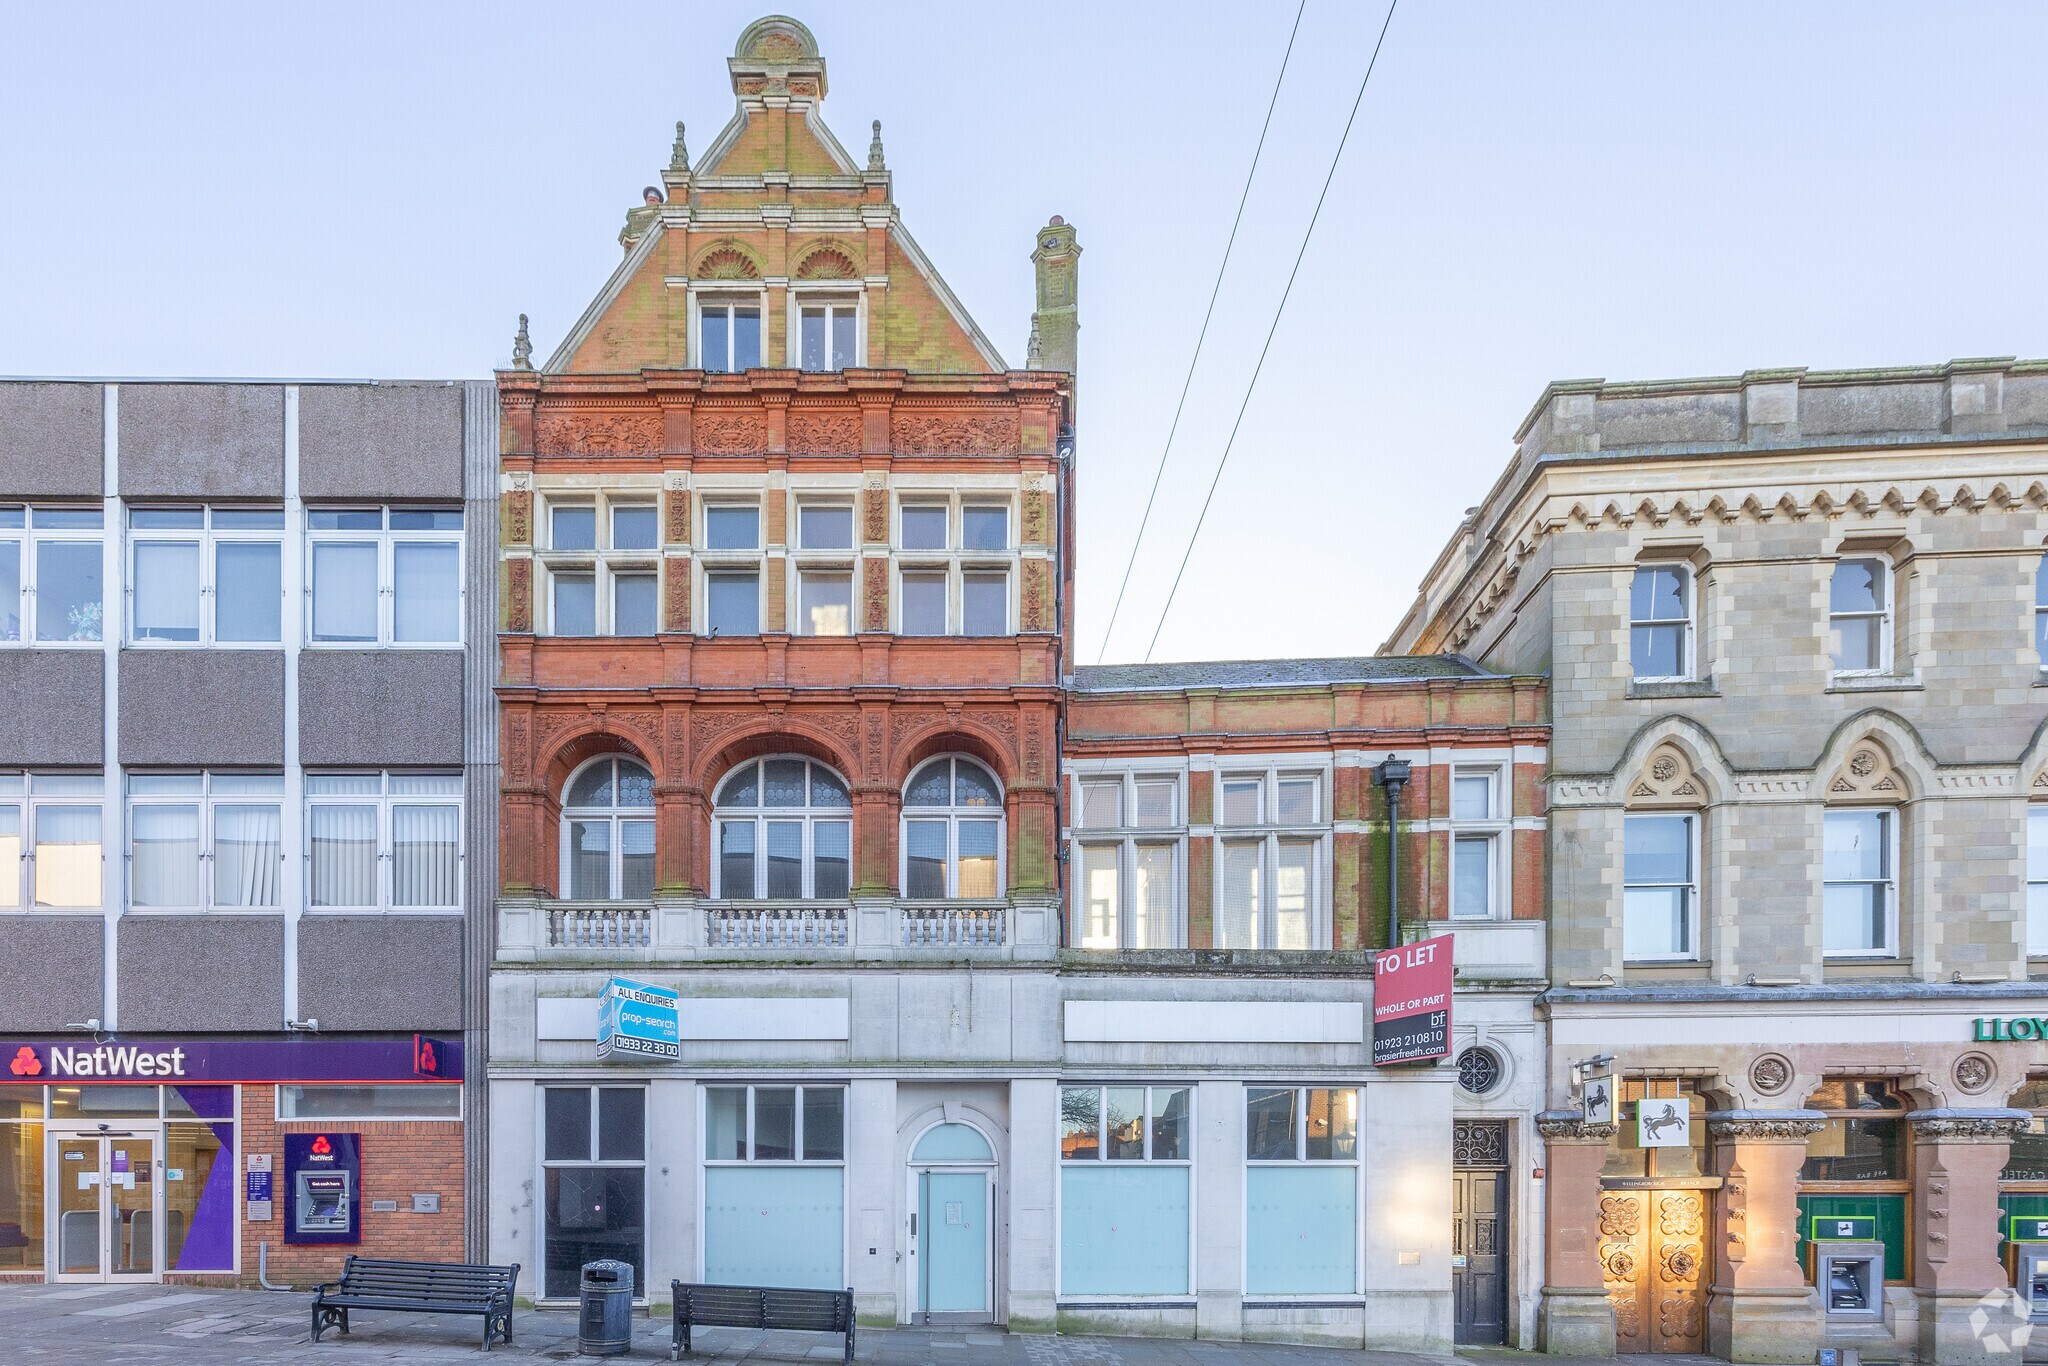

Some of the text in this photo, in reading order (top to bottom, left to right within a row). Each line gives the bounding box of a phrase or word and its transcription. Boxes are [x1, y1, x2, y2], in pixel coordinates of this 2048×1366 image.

[1376, 944, 1437, 975] TO LET
[618, 988, 633, 999] ALL
[634, 991, 675, 1008] ENQUIRIES
[1375, 994, 1445, 1016] WHOLE OR PART
[622, 1012, 676, 1029] prop-search
[616, 1037, 640, 1051] 01933
[642, 1041, 653, 1052] 22
[654, 1043, 665, 1053] 33
[666, 1045, 677, 1056] 00
[1374, 1030, 1443, 1051] 01923 210810
[51, 1046, 185, 1076] NatWest
[1374, 1045, 1445, 1062] brasierfreeth.com
